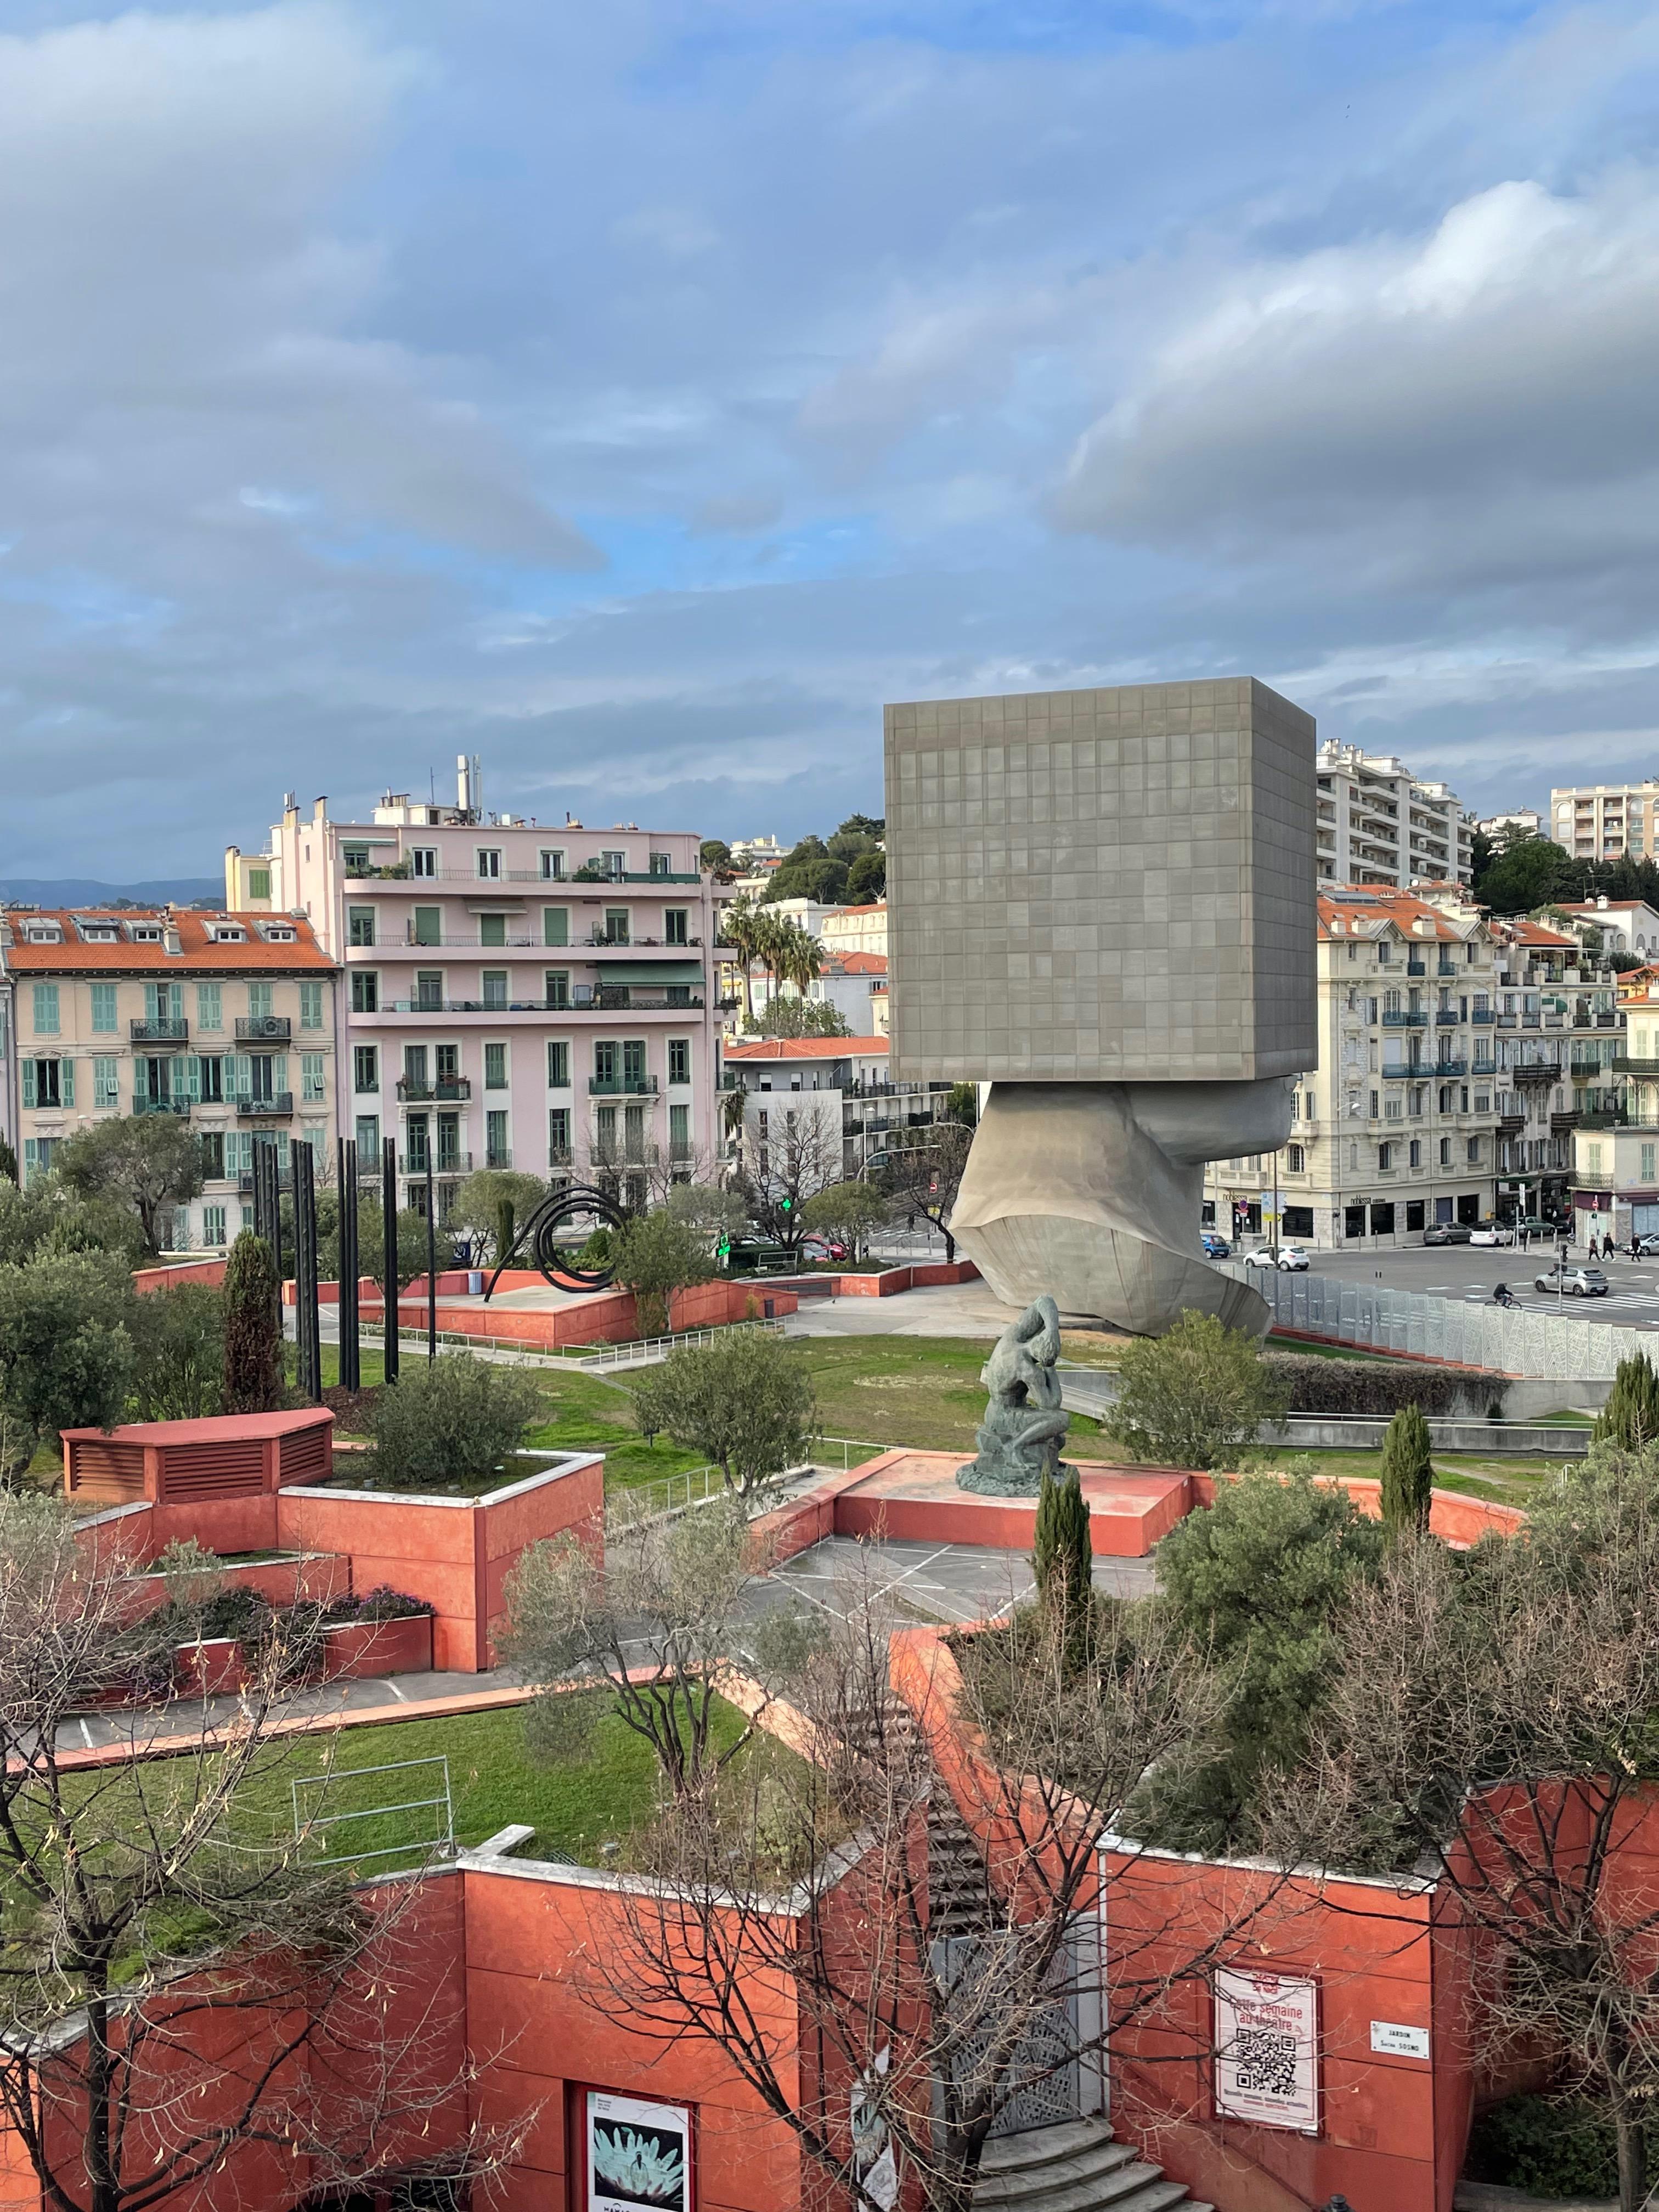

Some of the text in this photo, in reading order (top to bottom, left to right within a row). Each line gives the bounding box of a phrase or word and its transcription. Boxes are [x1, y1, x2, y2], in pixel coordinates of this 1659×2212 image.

[1260, 2005, 1302, 2019] semaine
[1239, 2013, 1252, 2024] au
[1389, 2030, 1410, 2038] JARDIN
